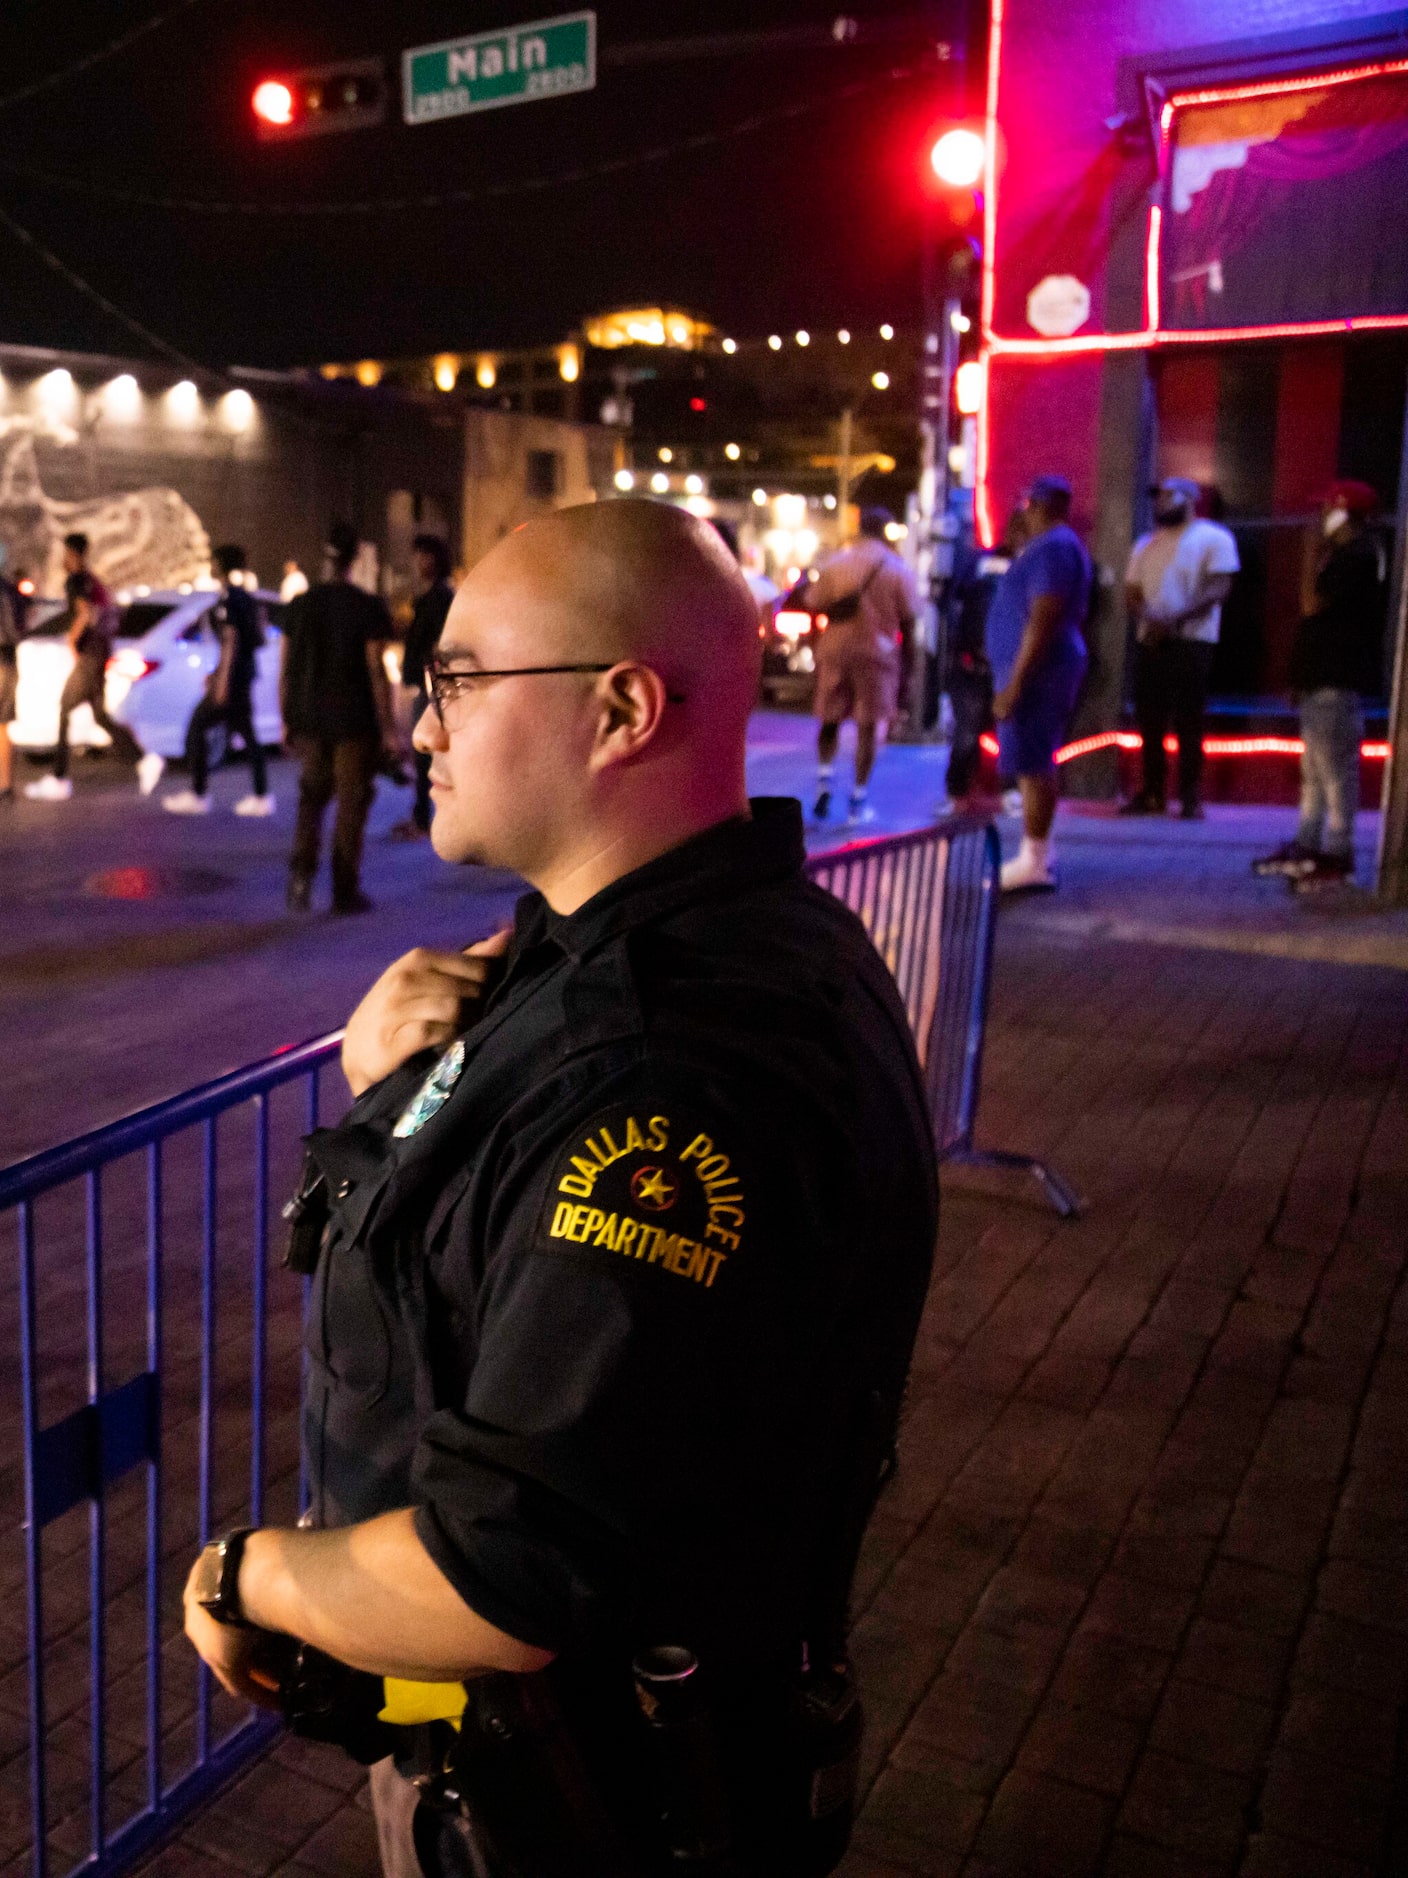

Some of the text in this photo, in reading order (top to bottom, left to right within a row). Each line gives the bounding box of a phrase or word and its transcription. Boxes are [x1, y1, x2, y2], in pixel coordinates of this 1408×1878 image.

[447, 35, 546, 84] Main
[558, 1116, 745, 1251] DALLAS POLICE
[550, 1201, 727, 1288] DEPARTMENT
